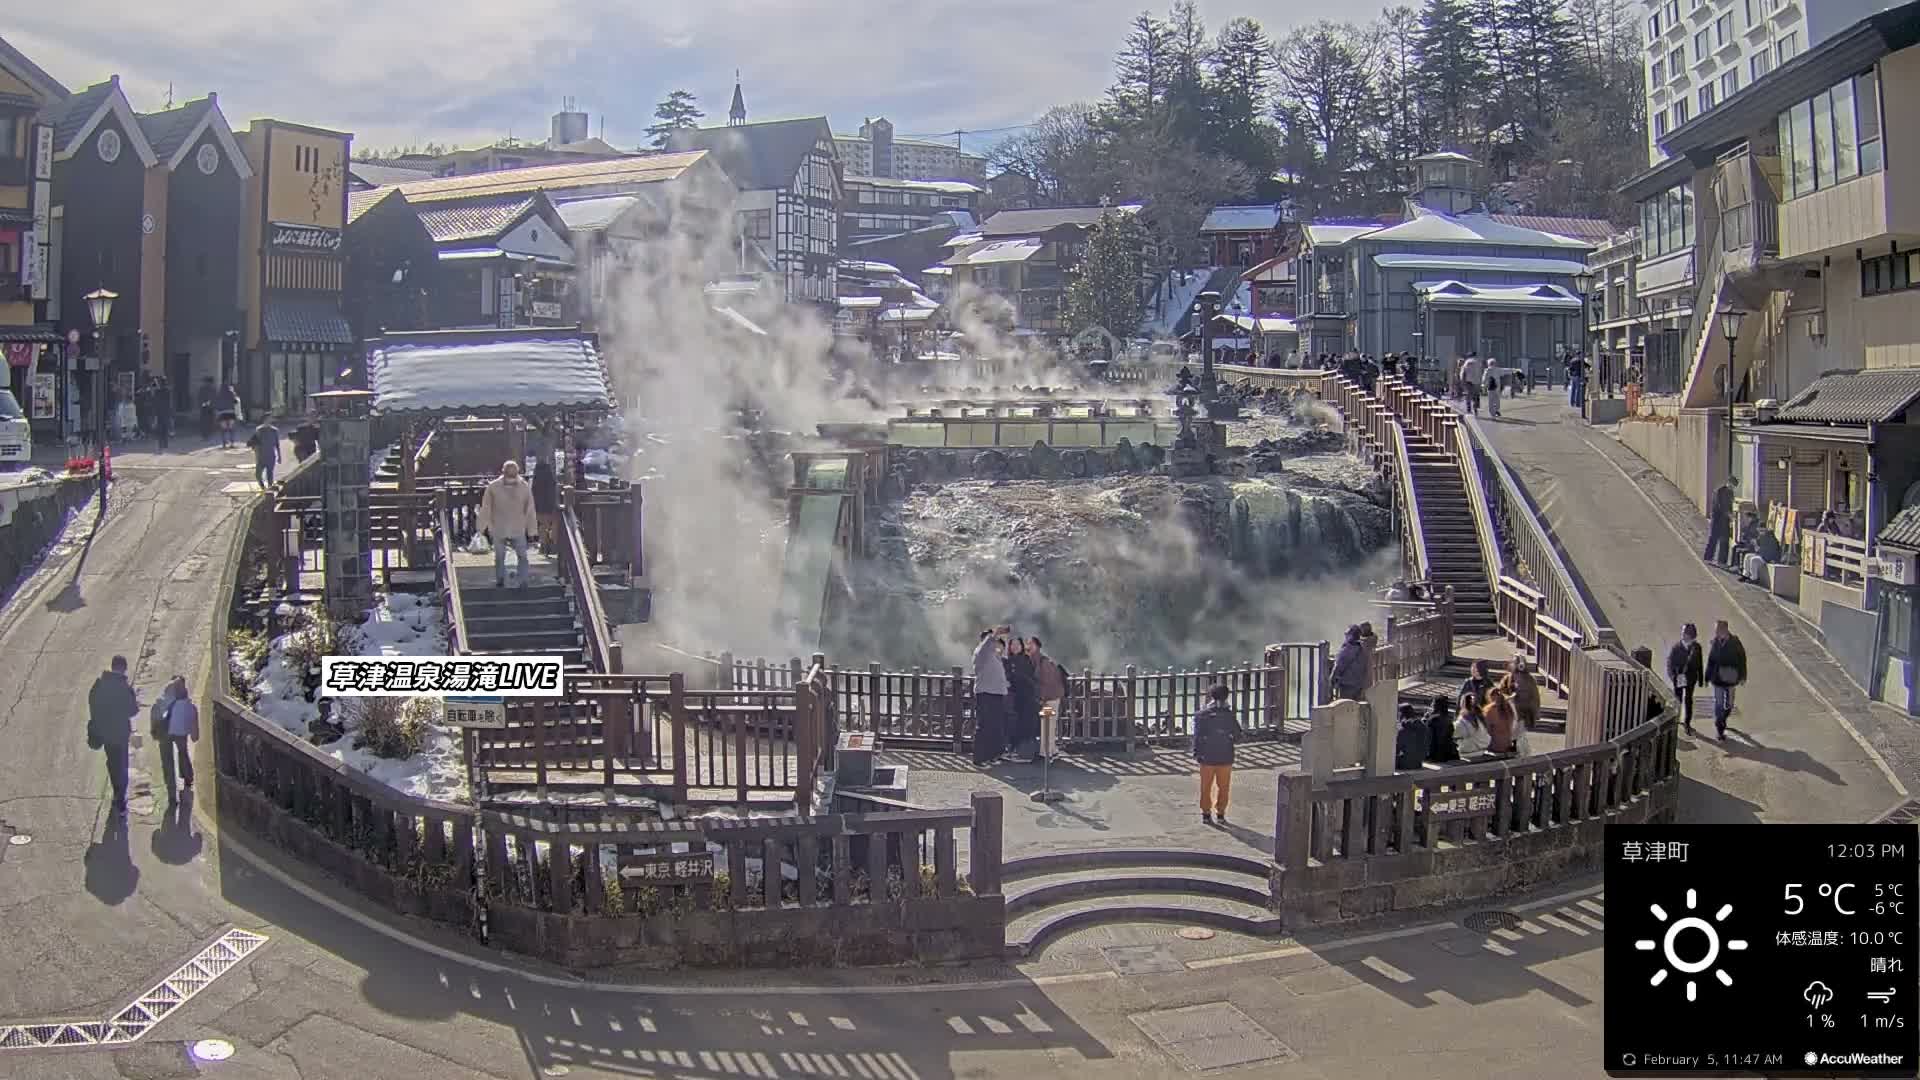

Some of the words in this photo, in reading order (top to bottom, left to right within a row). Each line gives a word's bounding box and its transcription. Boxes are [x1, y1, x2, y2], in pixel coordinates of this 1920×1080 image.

[447, 709, 503, 723] 自転車を除く
[644, 863, 672, 880] 東京
[674, 859, 713, 878] 軽井沢
